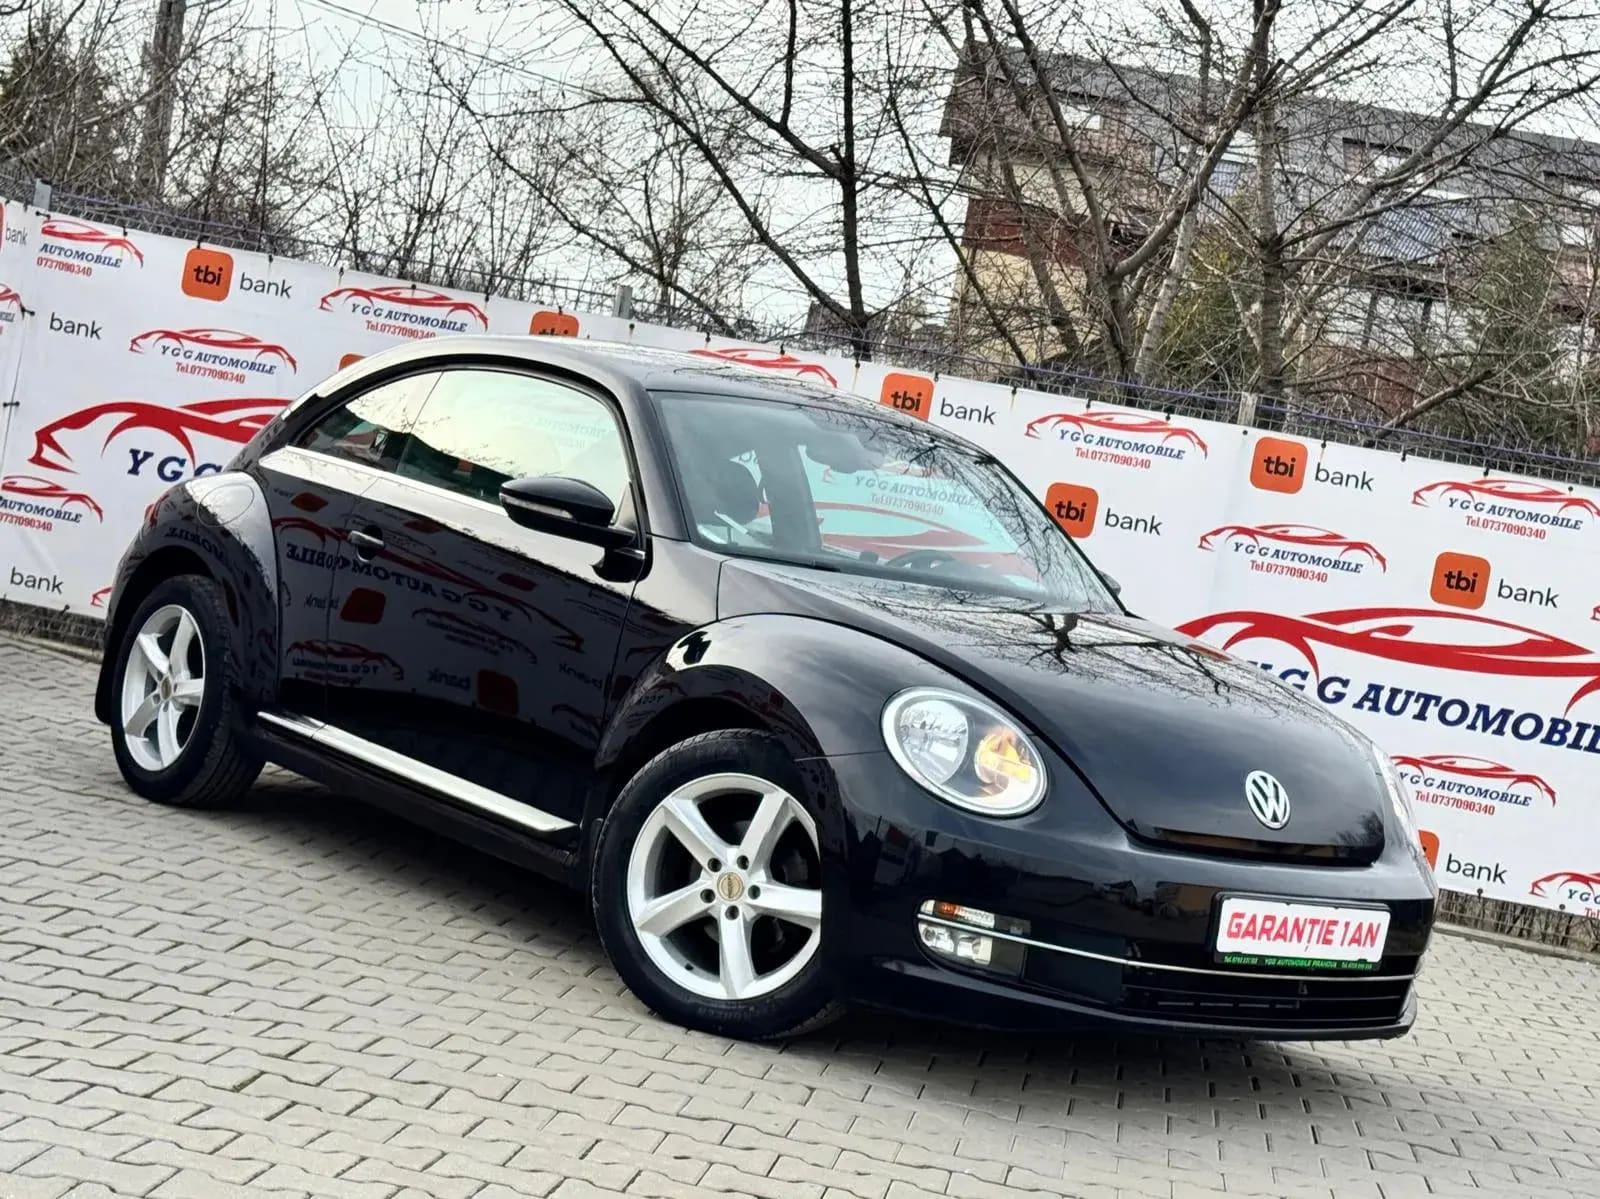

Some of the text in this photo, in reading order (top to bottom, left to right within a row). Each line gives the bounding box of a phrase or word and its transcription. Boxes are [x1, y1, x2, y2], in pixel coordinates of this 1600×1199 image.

[5, 222, 27, 245] bank
[37, 256, 92, 276] 0737090340
[40, 243, 121, 267] AUTOMOBILE
[193, 264, 292, 298] tbi bank
[49, 311, 102, 339] bank
[384, 310, 467, 332] AUTOMOBILE
[194, 351, 276, 374] AUTOMOBILE
[890, 390, 997, 425] tbi bank
[1096, 435, 1185, 460] AUTOMOBILE
[1263, 456, 1374, 491] tbi bank
[1055, 500, 1163, 536] tbi bank
[1486, 504, 1583, 530] AUTOMOBILE
[1271, 550, 1363, 573] AUTOMOBILE
[9, 566, 64, 594] bank
[1444, 570, 1559, 608] tbi bank
[1436, 779, 1532, 806] AUTOMOBILE
[1445, 853, 1508, 884] bank
[1226, 911, 1338, 951] GARANȚIE
[1347, 921, 1381, 947] AN
